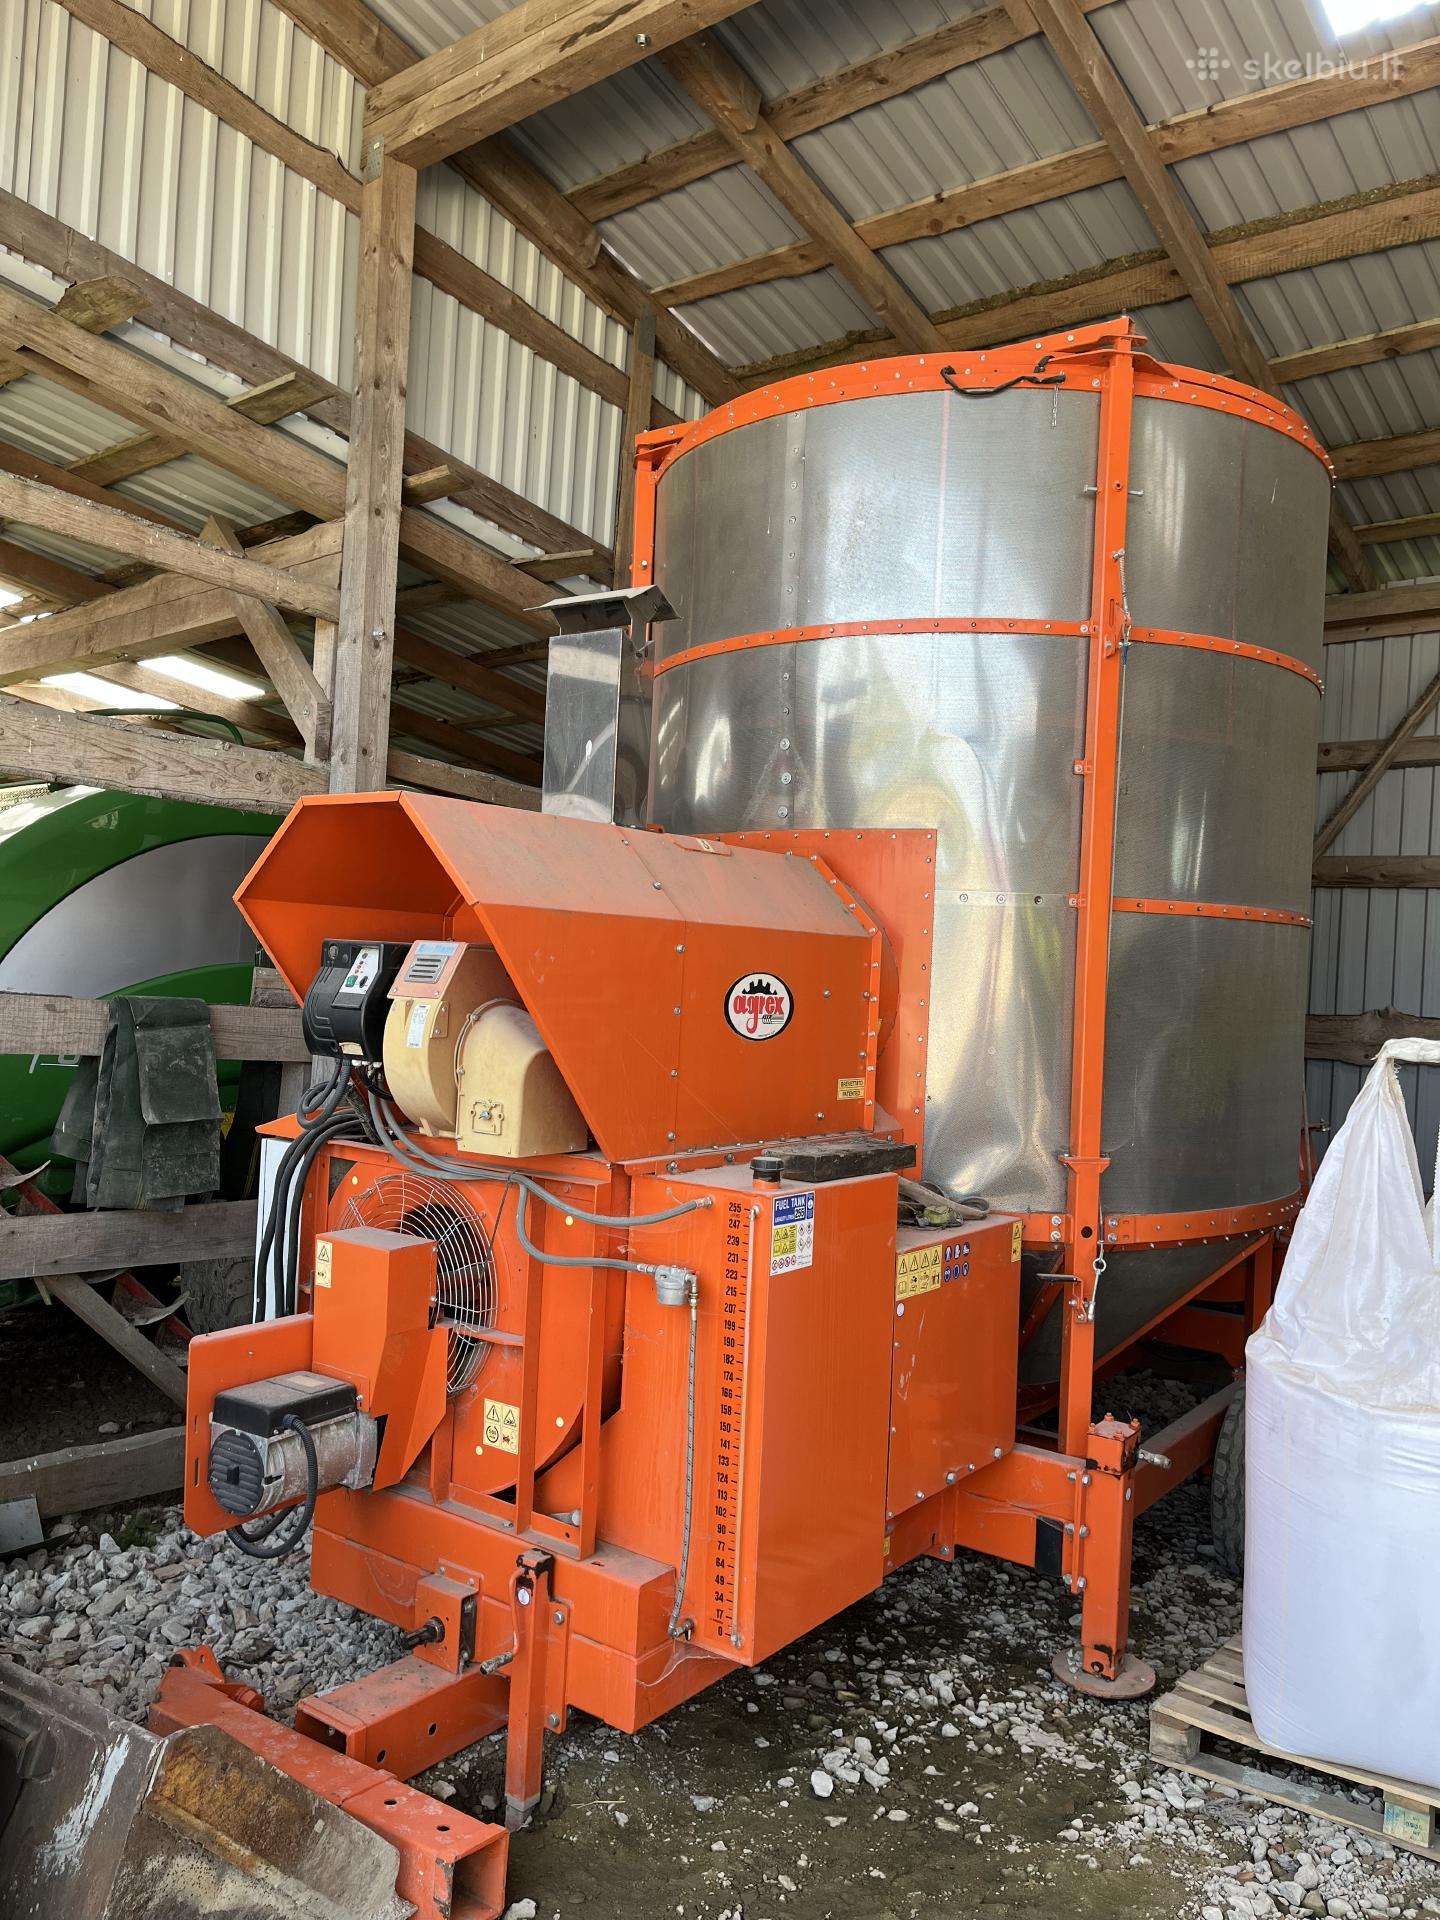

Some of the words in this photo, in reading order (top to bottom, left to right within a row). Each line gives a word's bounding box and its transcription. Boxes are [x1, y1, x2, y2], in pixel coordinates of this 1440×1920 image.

[733, 995, 785, 1034] agrex
[728, 1201, 742, 1213] 255
[775, 1199, 790, 1211] FUEL
[791, 1195, 806, 1208] TANK
[728, 1218, 741, 1230] 247
[727, 1235, 740, 1246] 239
[727, 1252, 739, 1263] 231
[725, 1269, 738, 1280] 223
[725, 1285, 737, 1297] 215
[724, 1302, 737, 1314] 207
[724, 1320, 736, 1331] 199
[723, 1336, 735, 1348] 190
[723, 1353, 735, 1365] 182
[720, 1404, 732, 1416] 158
[719, 1421, 731, 1433] 150
[720, 1438, 731, 1450] 141
[718, 1454, 730, 1467] 133
[717, 1472, 729, 1484] 124
[717, 1489, 728, 1501] 113
[715, 1505, 727, 1518] 102
[717, 1523, 727, 1535] 90
[717, 1540, 726, 1552] 77
[715, 1557, 725, 1568] 64
[714, 1574, 725, 1585] 49
[714, 1591, 724, 1603] 34
[716, 1608, 725, 1619] 17
